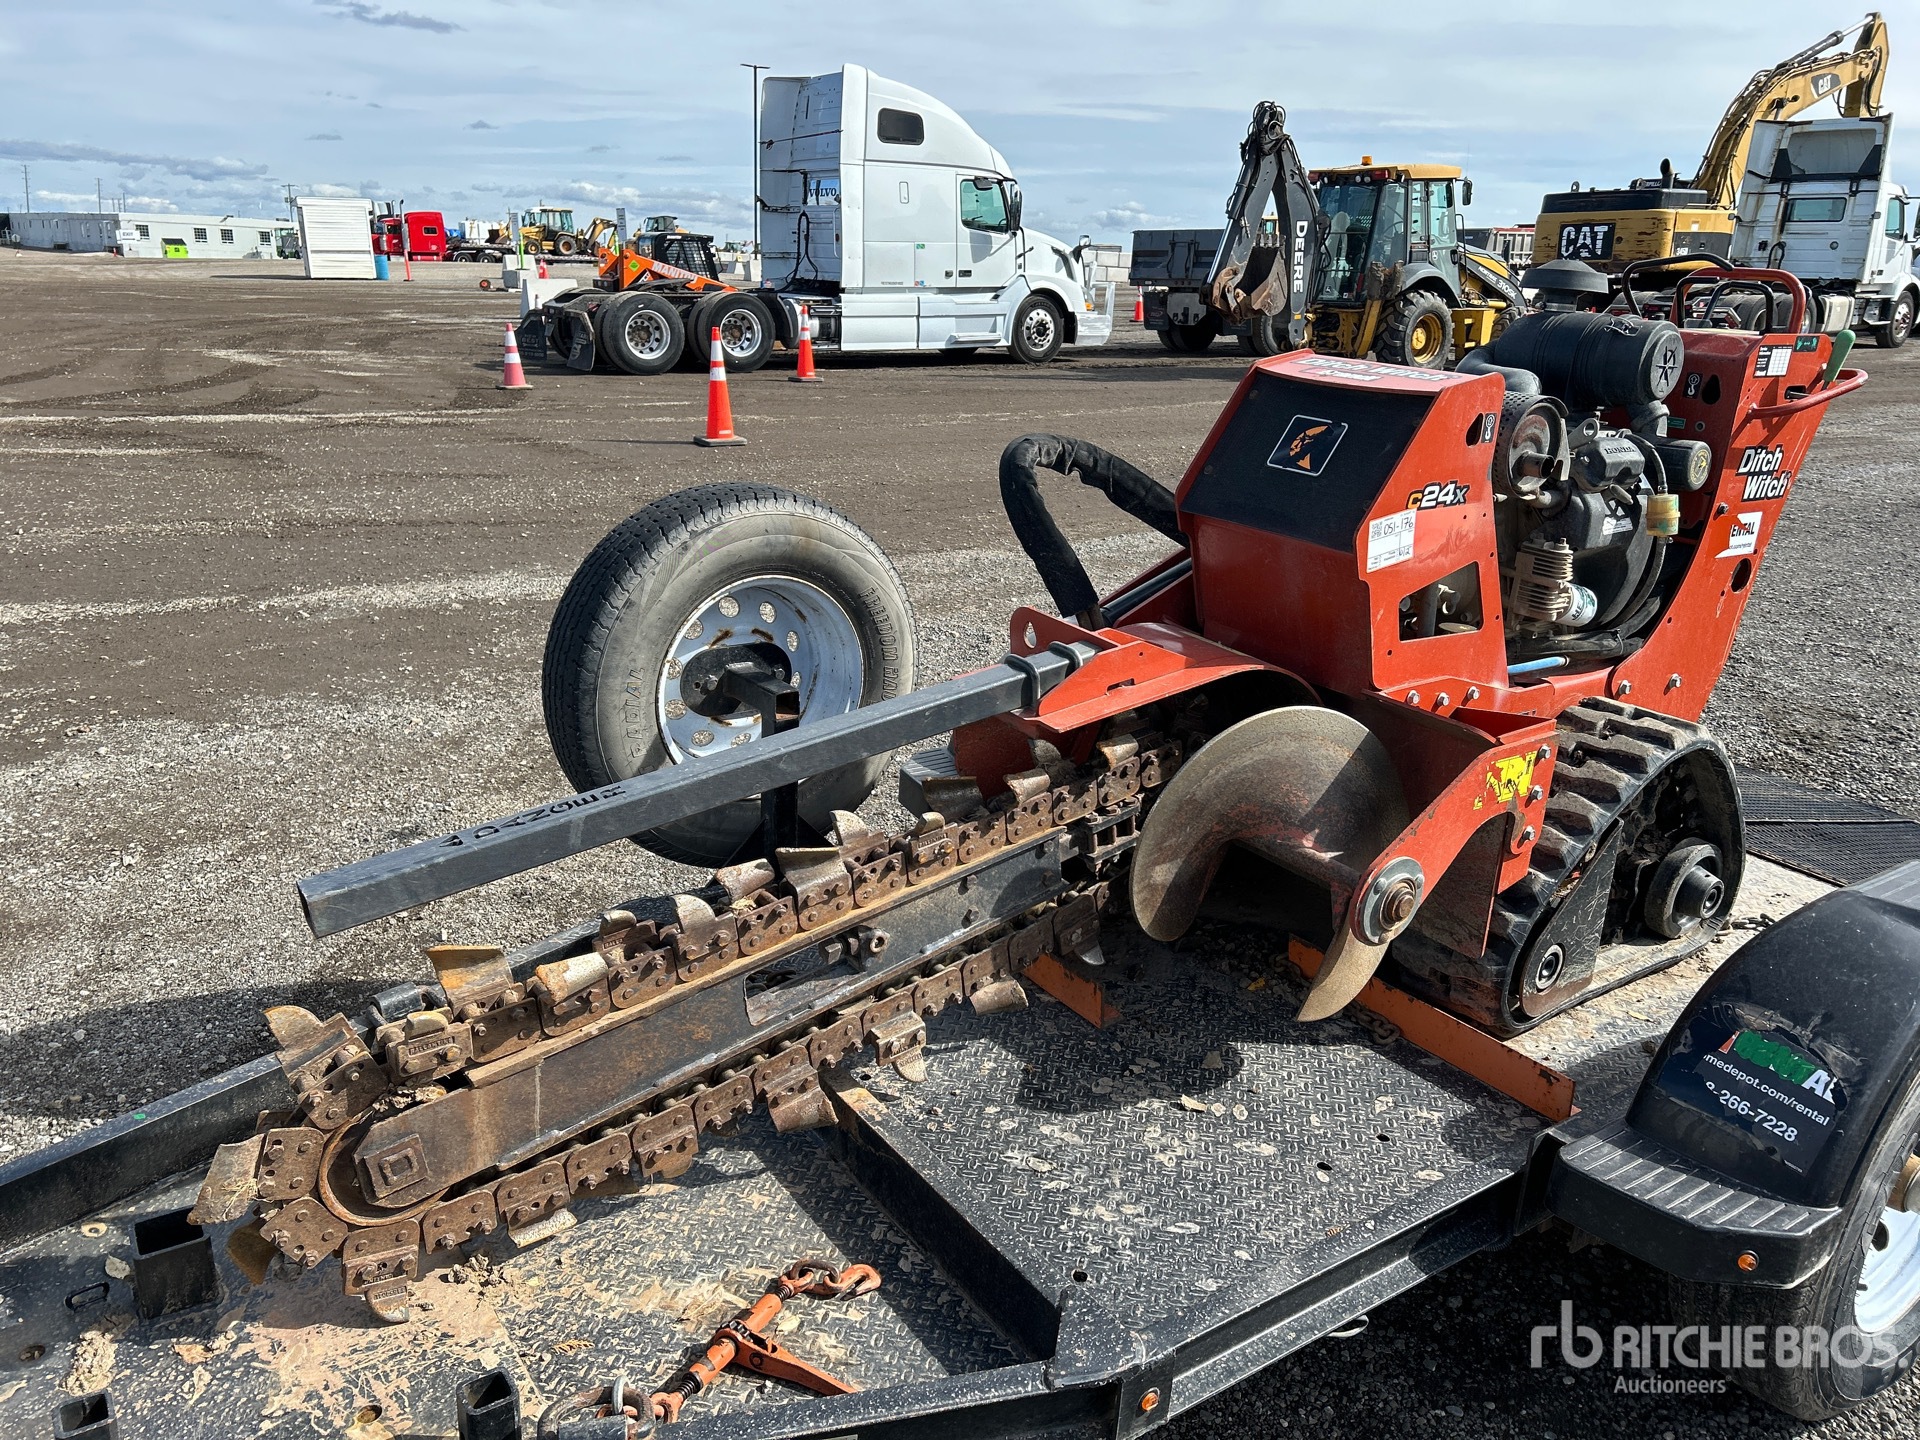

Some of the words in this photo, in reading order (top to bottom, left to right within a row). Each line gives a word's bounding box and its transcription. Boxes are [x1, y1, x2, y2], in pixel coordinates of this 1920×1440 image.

[1818, 74, 1832, 95] CAT
[1293, 220, 1309, 293] DEERE
[1561, 225, 1609, 257] CAT
[1297, 358, 1369, 371] Ditch
[1369, 366, 1448, 382] Witch
[1736, 445, 1783, 475] Ditch
[1742, 470, 1789, 500] Witch
[860, 587, 899, 661] FREEDOM
[882, 666, 899, 701] HAU
[625, 667, 647, 758] RADIAL
[473, 785, 627, 840] DANGER
[1703, 1053, 1831, 1127] medepot.com/rental
